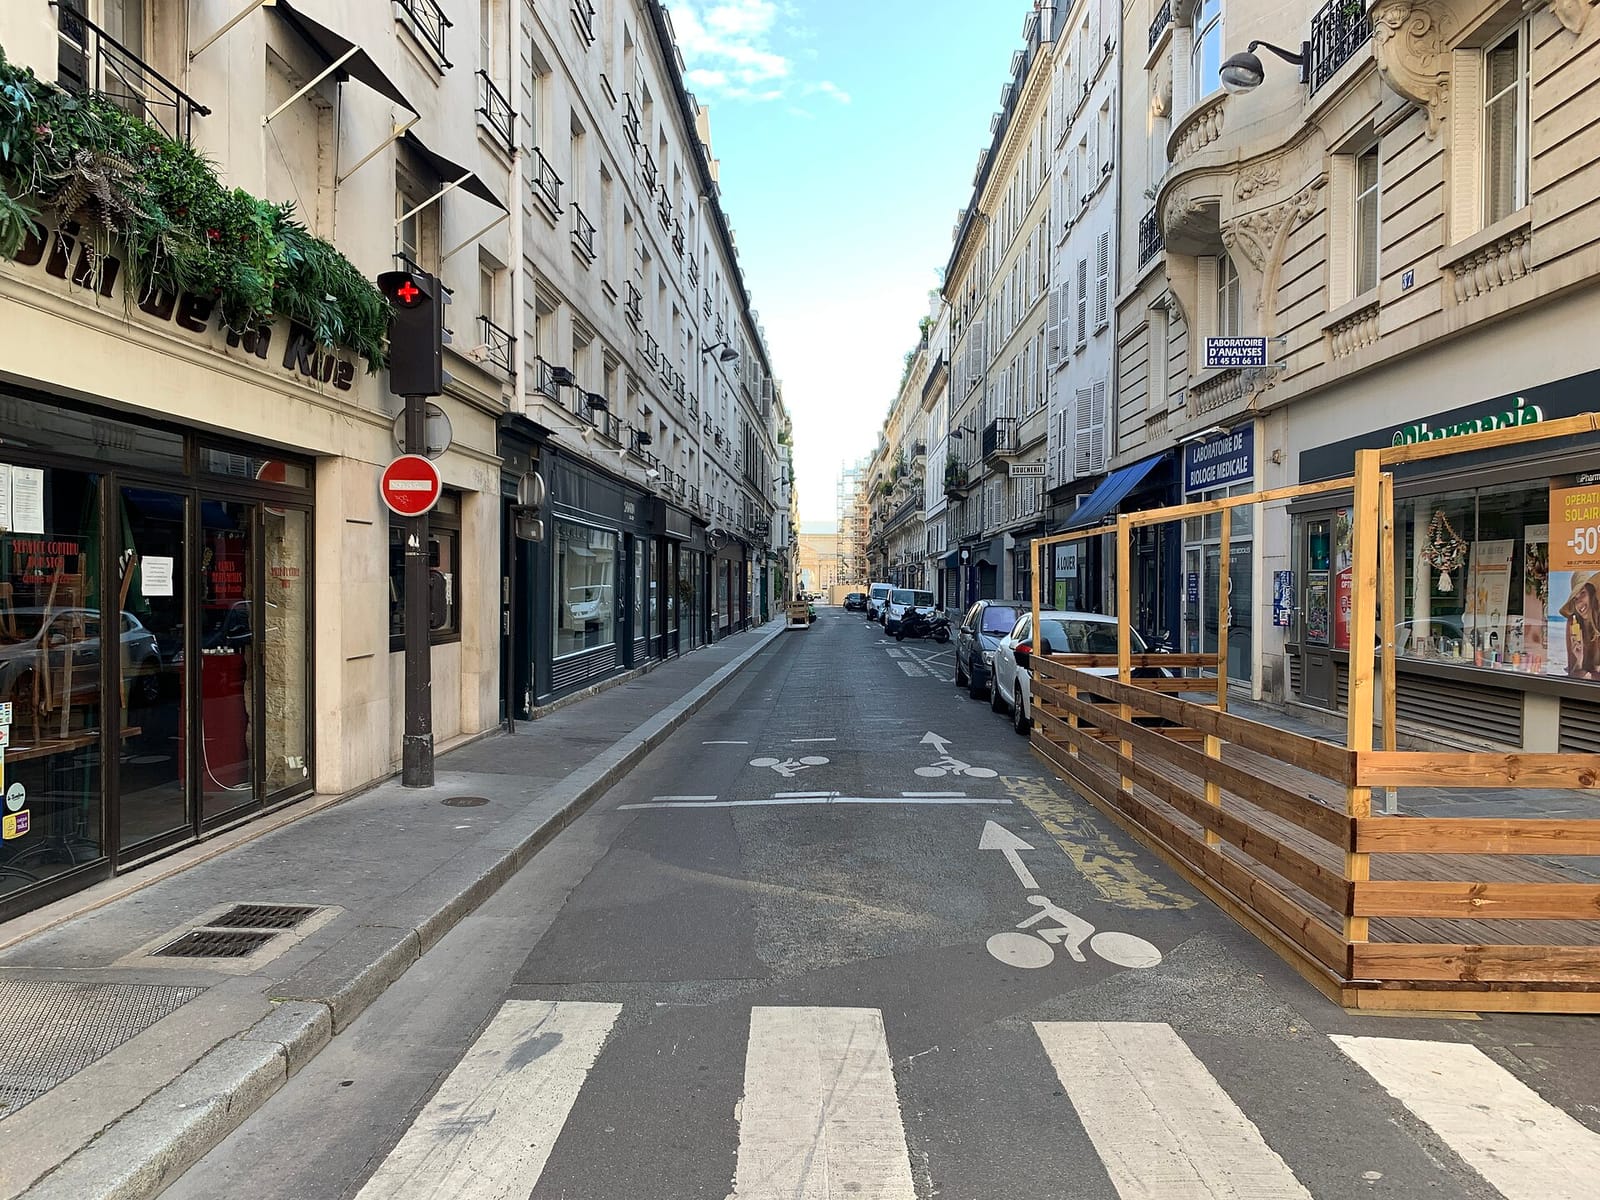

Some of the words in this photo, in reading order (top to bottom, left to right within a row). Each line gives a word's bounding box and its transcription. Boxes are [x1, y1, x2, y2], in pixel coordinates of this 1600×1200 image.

[1208, 339, 1263, 347] LABORATOIRE
[1209, 348, 1262, 357] D'ANALYSES
[1209, 357, 1218, 365] 01
[1220, 357, 1230, 365] 45
[1231, 357, 1240, 365] 51
[1242, 357, 1252, 365] 66
[1253, 357, 1262, 365] 11
[1193, 436, 1233, 464] LABORATOIRE
[1233, 432, 1243, 452] DE
[1012, 466, 1043, 474] BOUCHERIE
[1190, 464, 1217, 487] BIOLOGIE
[1216, 455, 1248, 480] MEDICALE
[1565, 507, 1600, 522] SOLAIR
